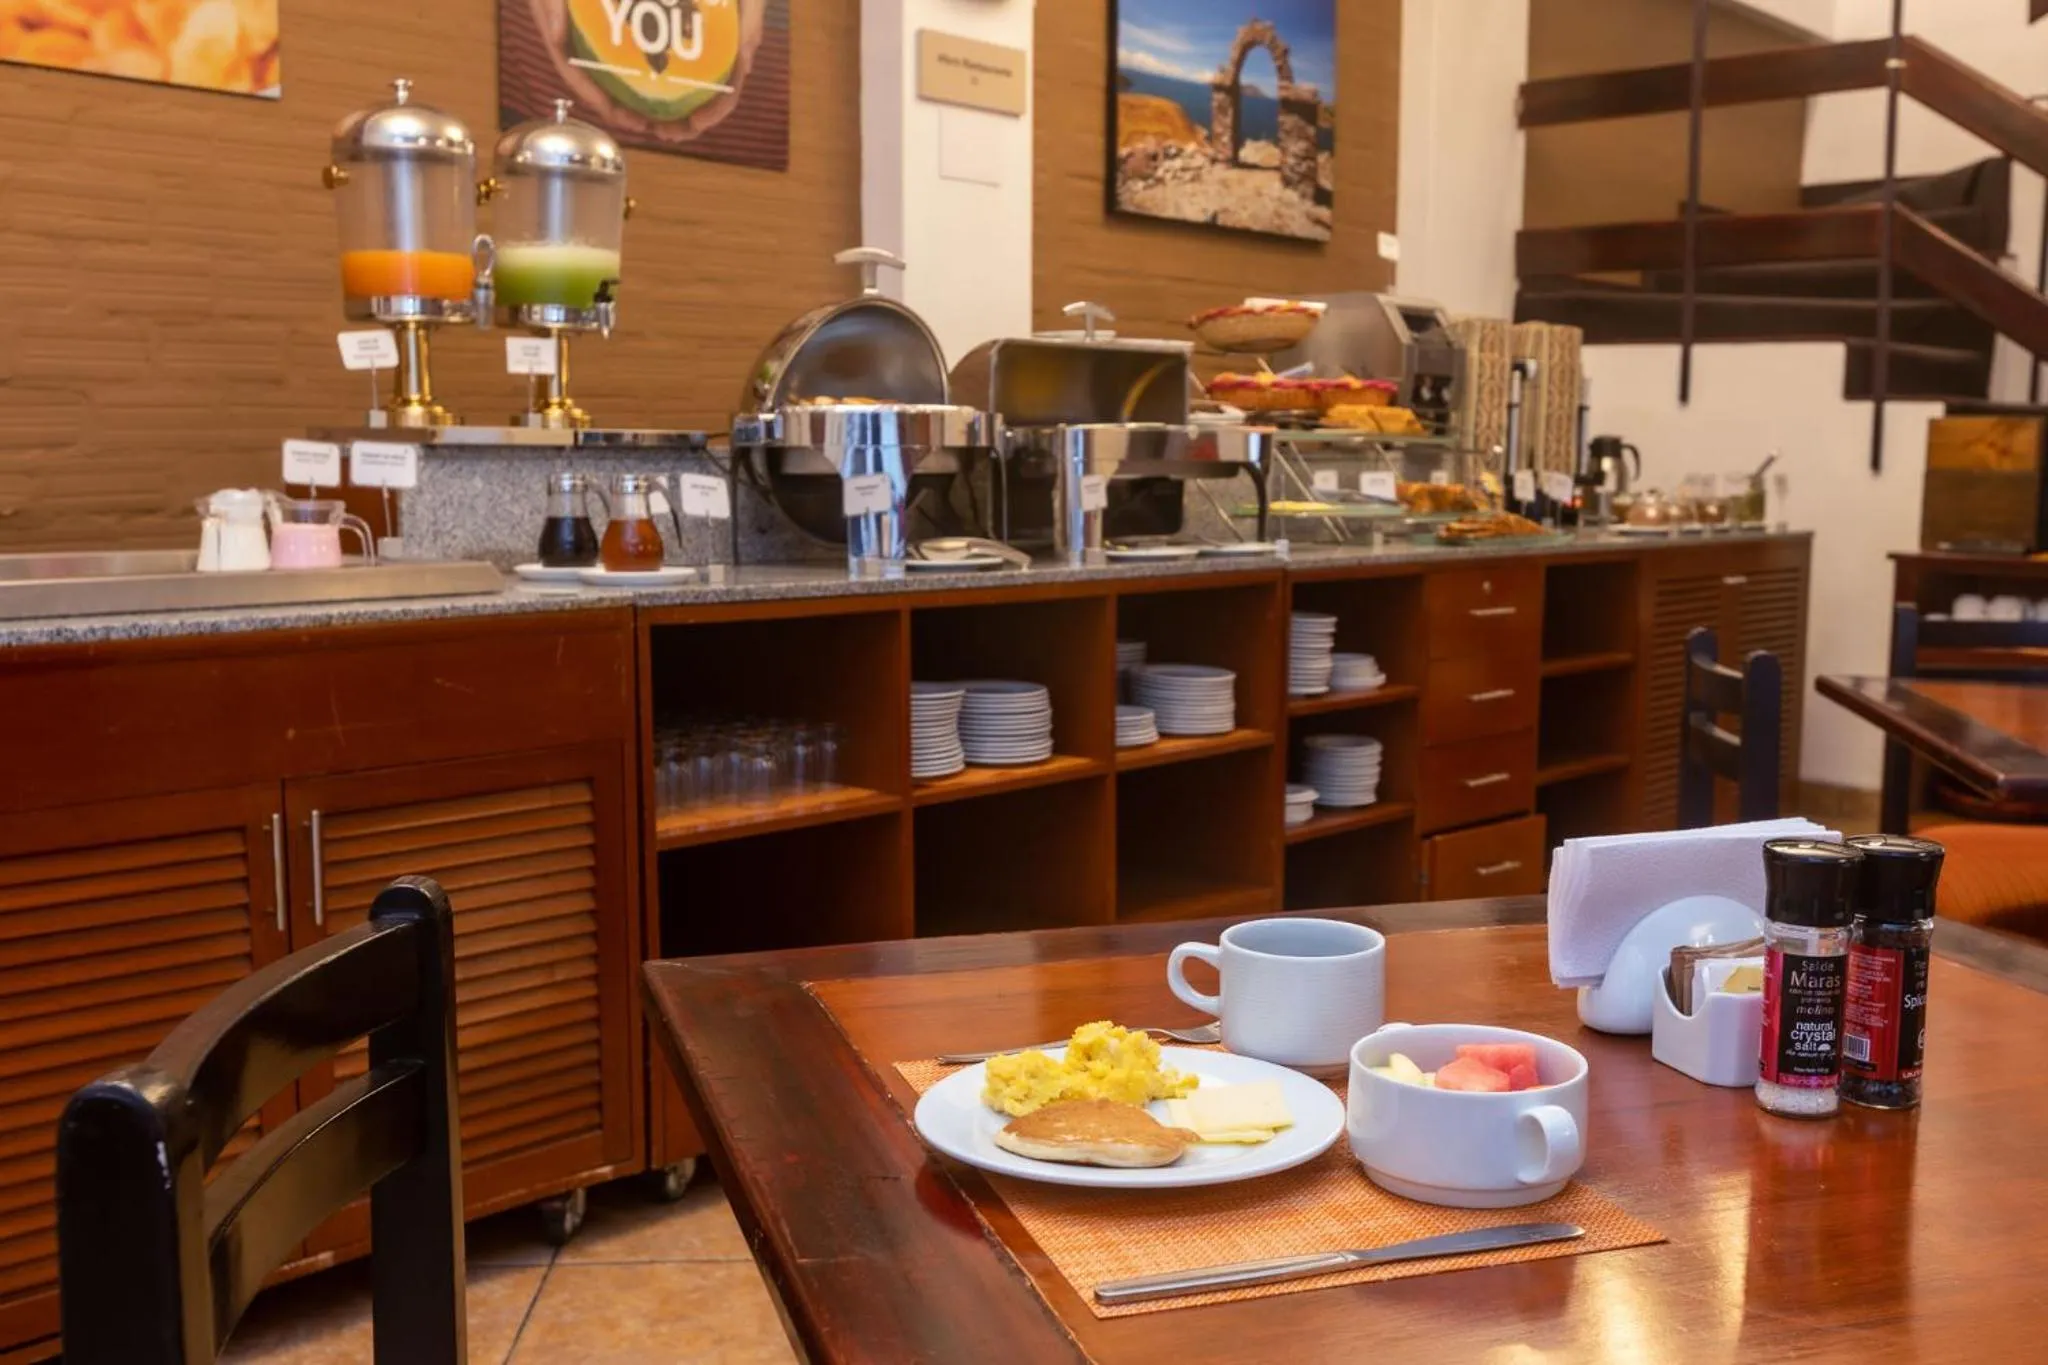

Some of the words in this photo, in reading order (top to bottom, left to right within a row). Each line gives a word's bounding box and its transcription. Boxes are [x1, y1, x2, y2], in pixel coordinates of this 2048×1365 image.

[601, 0, 703, 60] YOU
[1790, 970, 1840, 988] Maras
[1796, 1020, 1833, 1031] natural
[1790, 1027, 1836, 1044] crystal
[1794, 1042, 1817, 1051] salt
